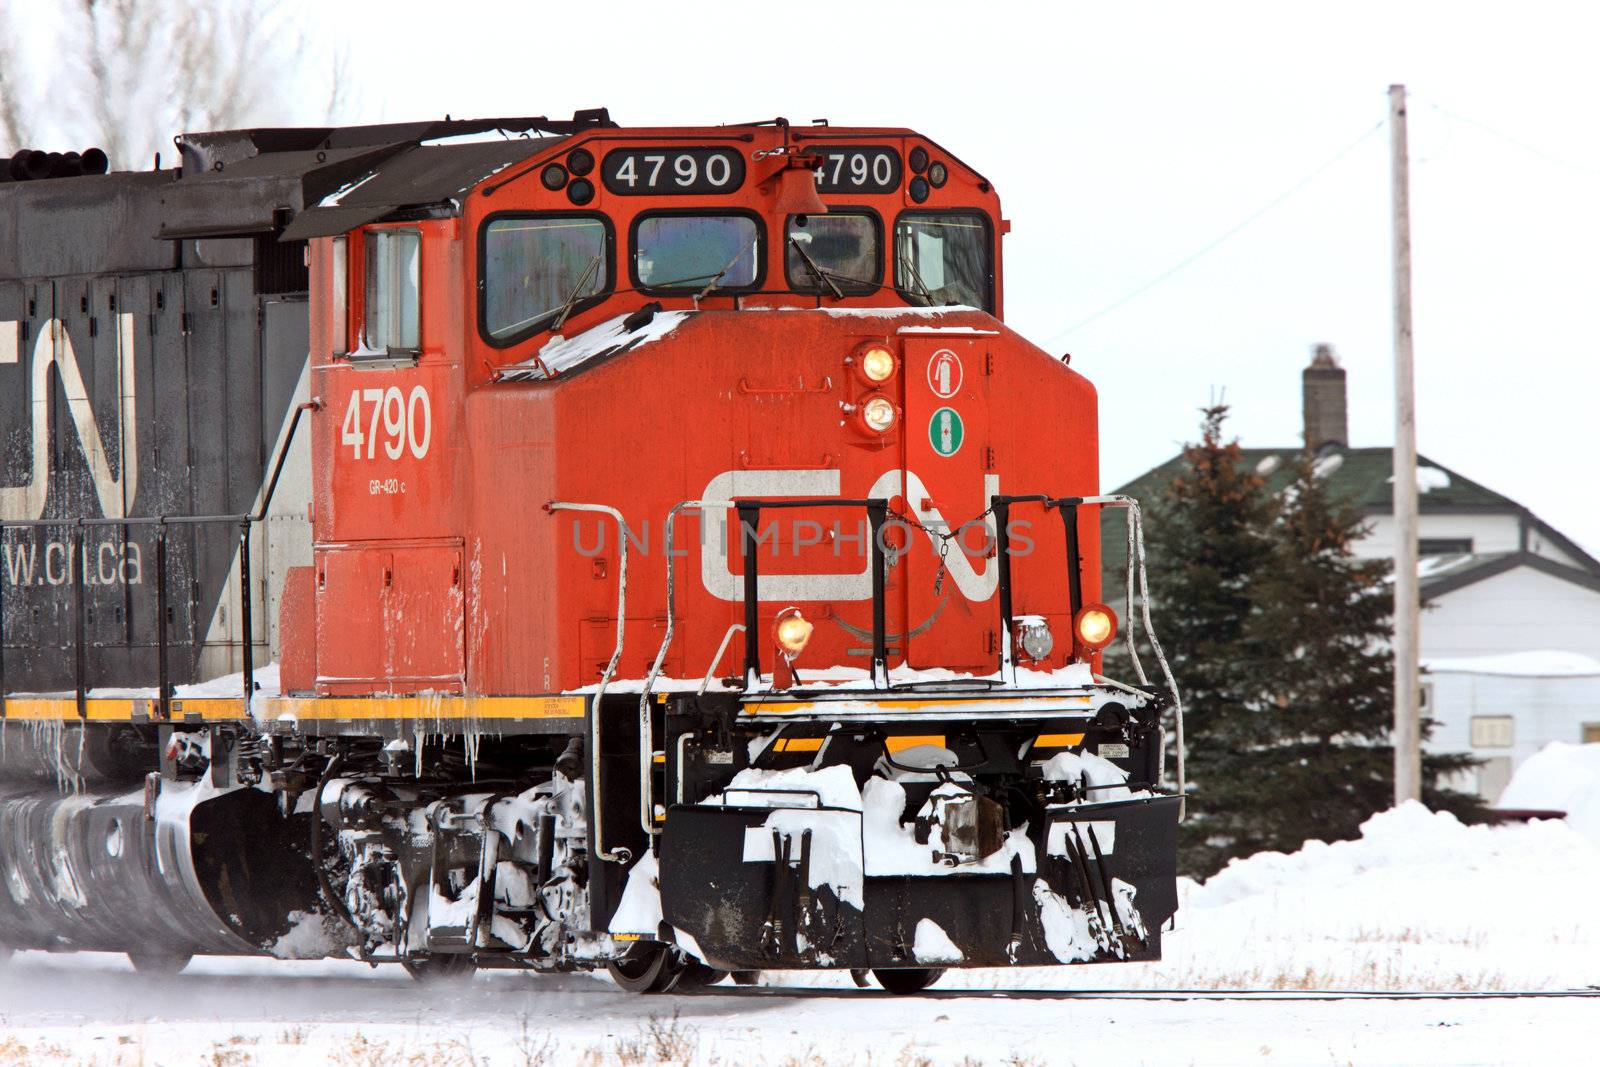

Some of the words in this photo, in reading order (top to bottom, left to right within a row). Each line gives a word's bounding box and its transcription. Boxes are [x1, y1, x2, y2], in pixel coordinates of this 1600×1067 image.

[615, 154, 731, 187] 4790
[341, 384, 432, 460] 4790
[369, 478, 399, 495] GR-420
[701, 469, 1000, 601] CN
